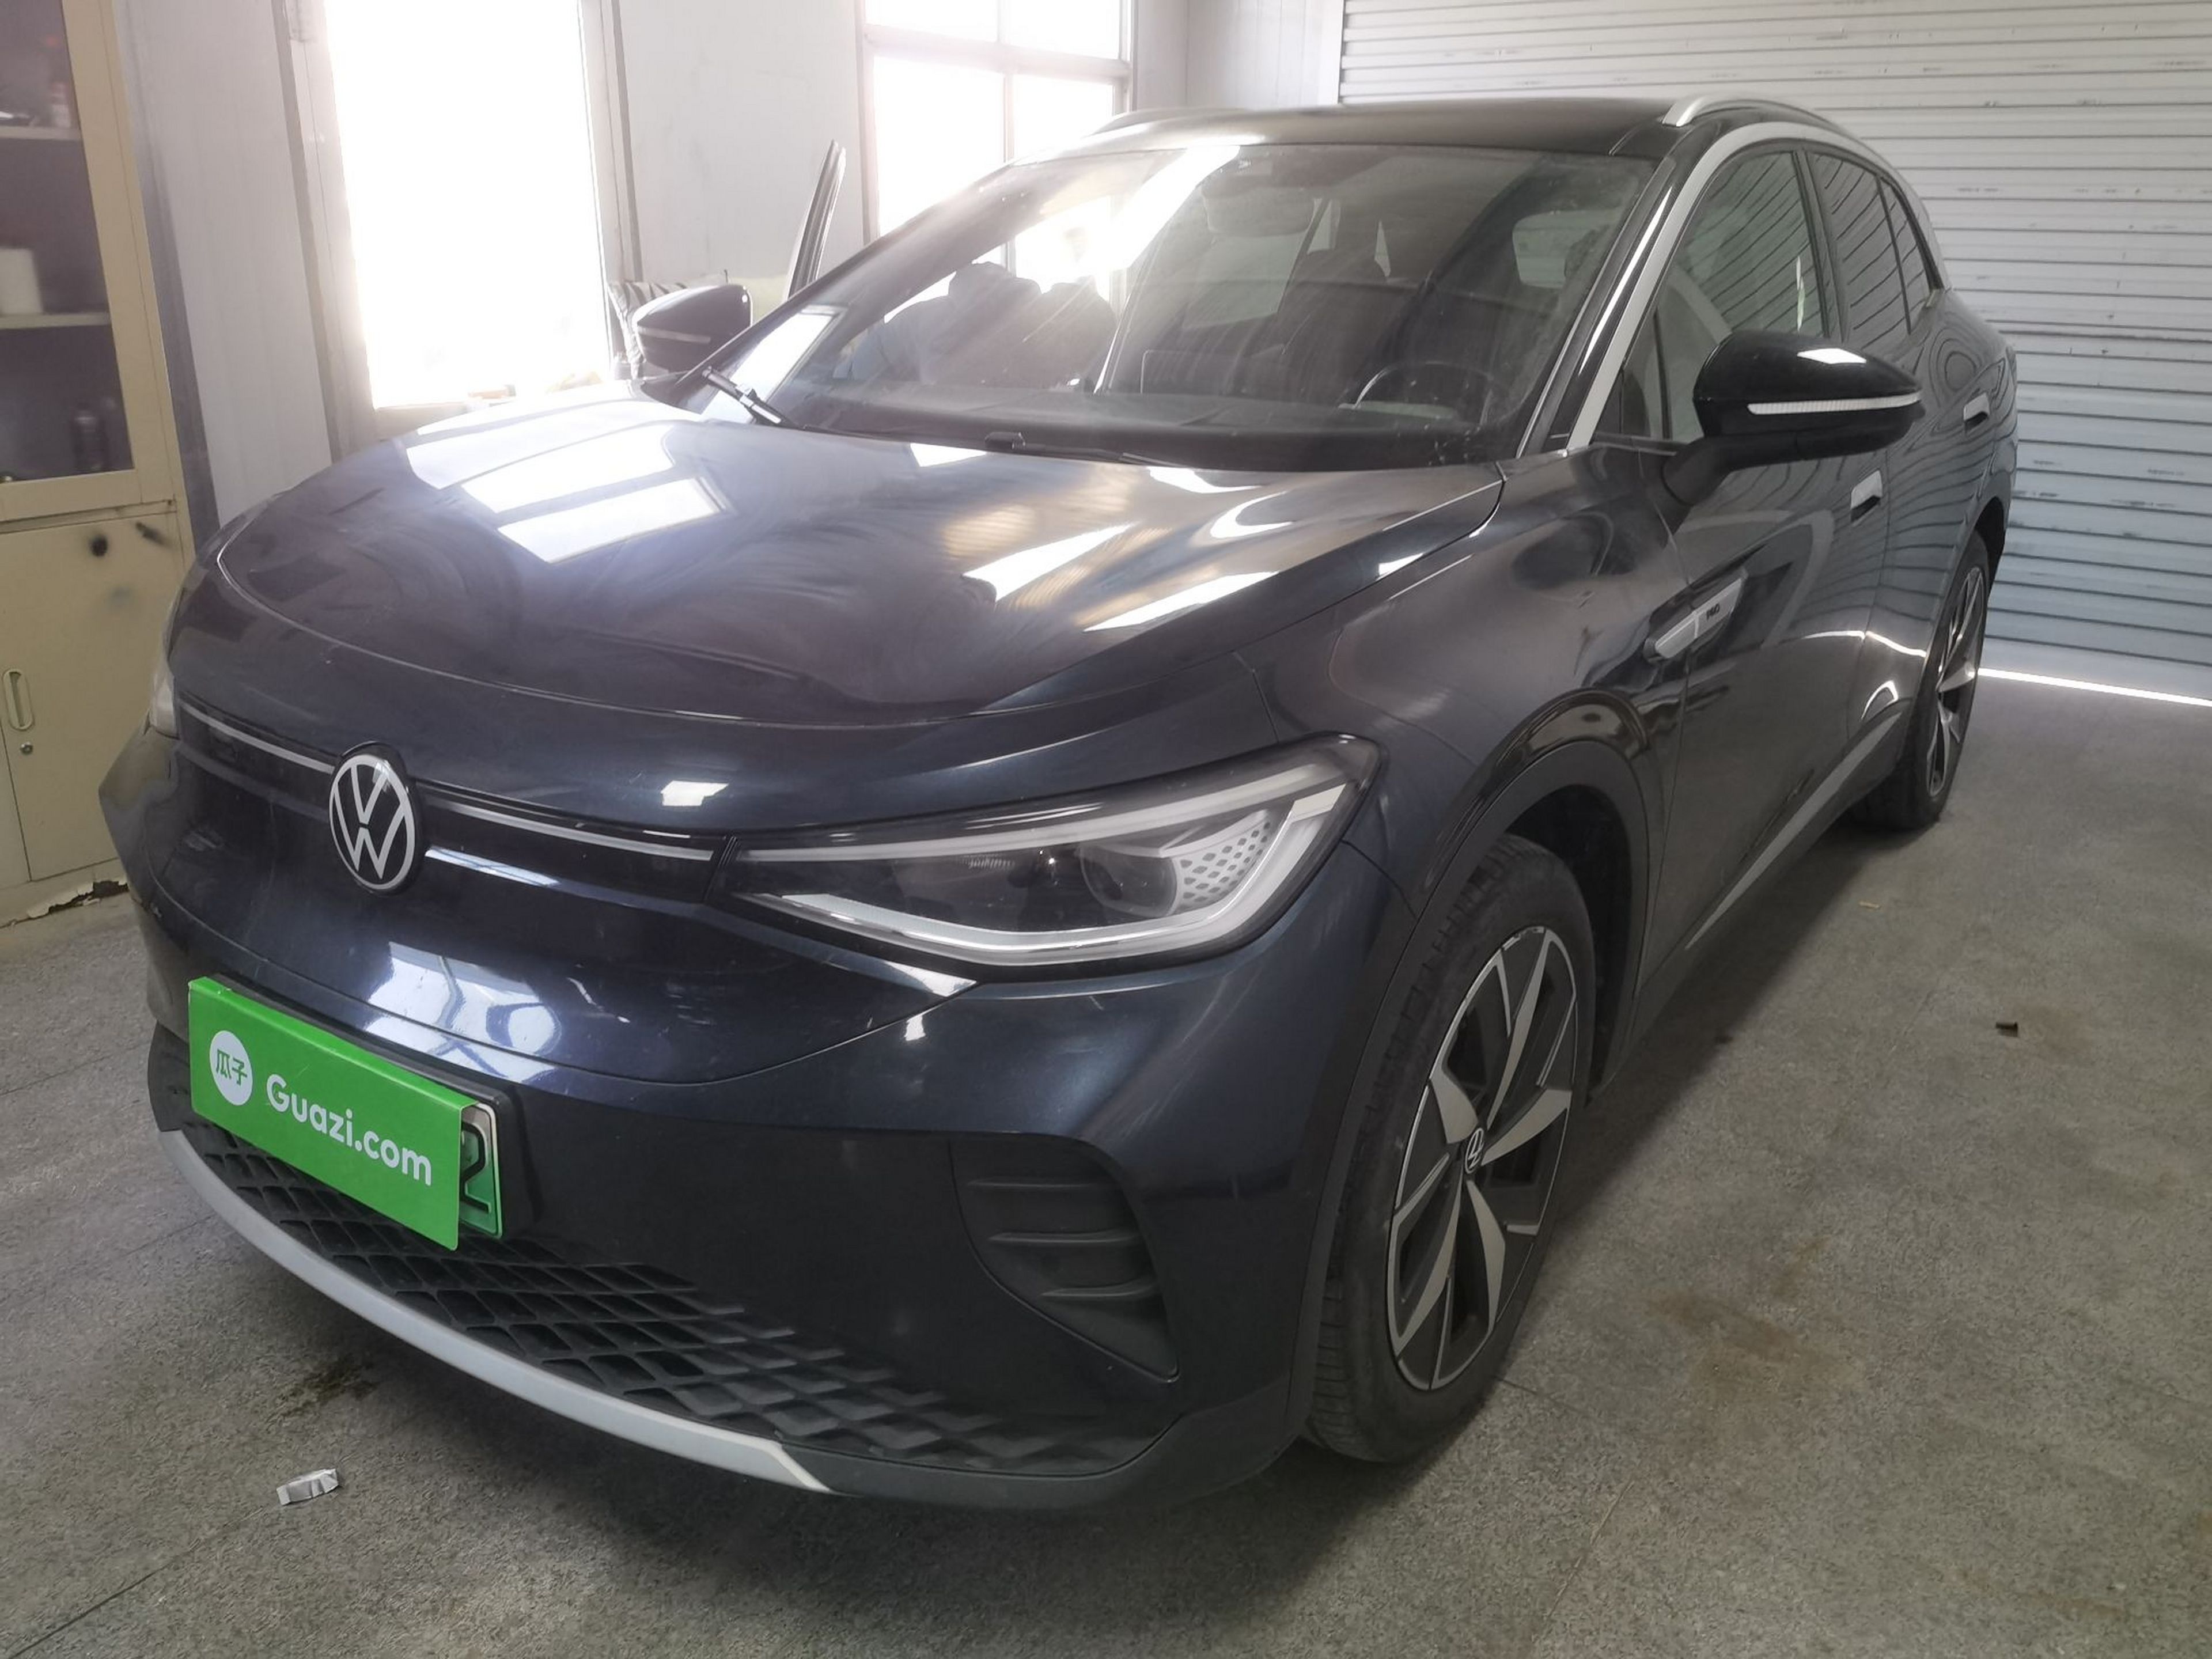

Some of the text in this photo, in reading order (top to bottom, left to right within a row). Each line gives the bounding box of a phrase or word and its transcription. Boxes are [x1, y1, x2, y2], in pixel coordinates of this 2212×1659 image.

[330, 757, 411, 884] VW
[215, 1048, 248, 1086] 瓜子
[266, 1074, 432, 1187] Guazi.com
